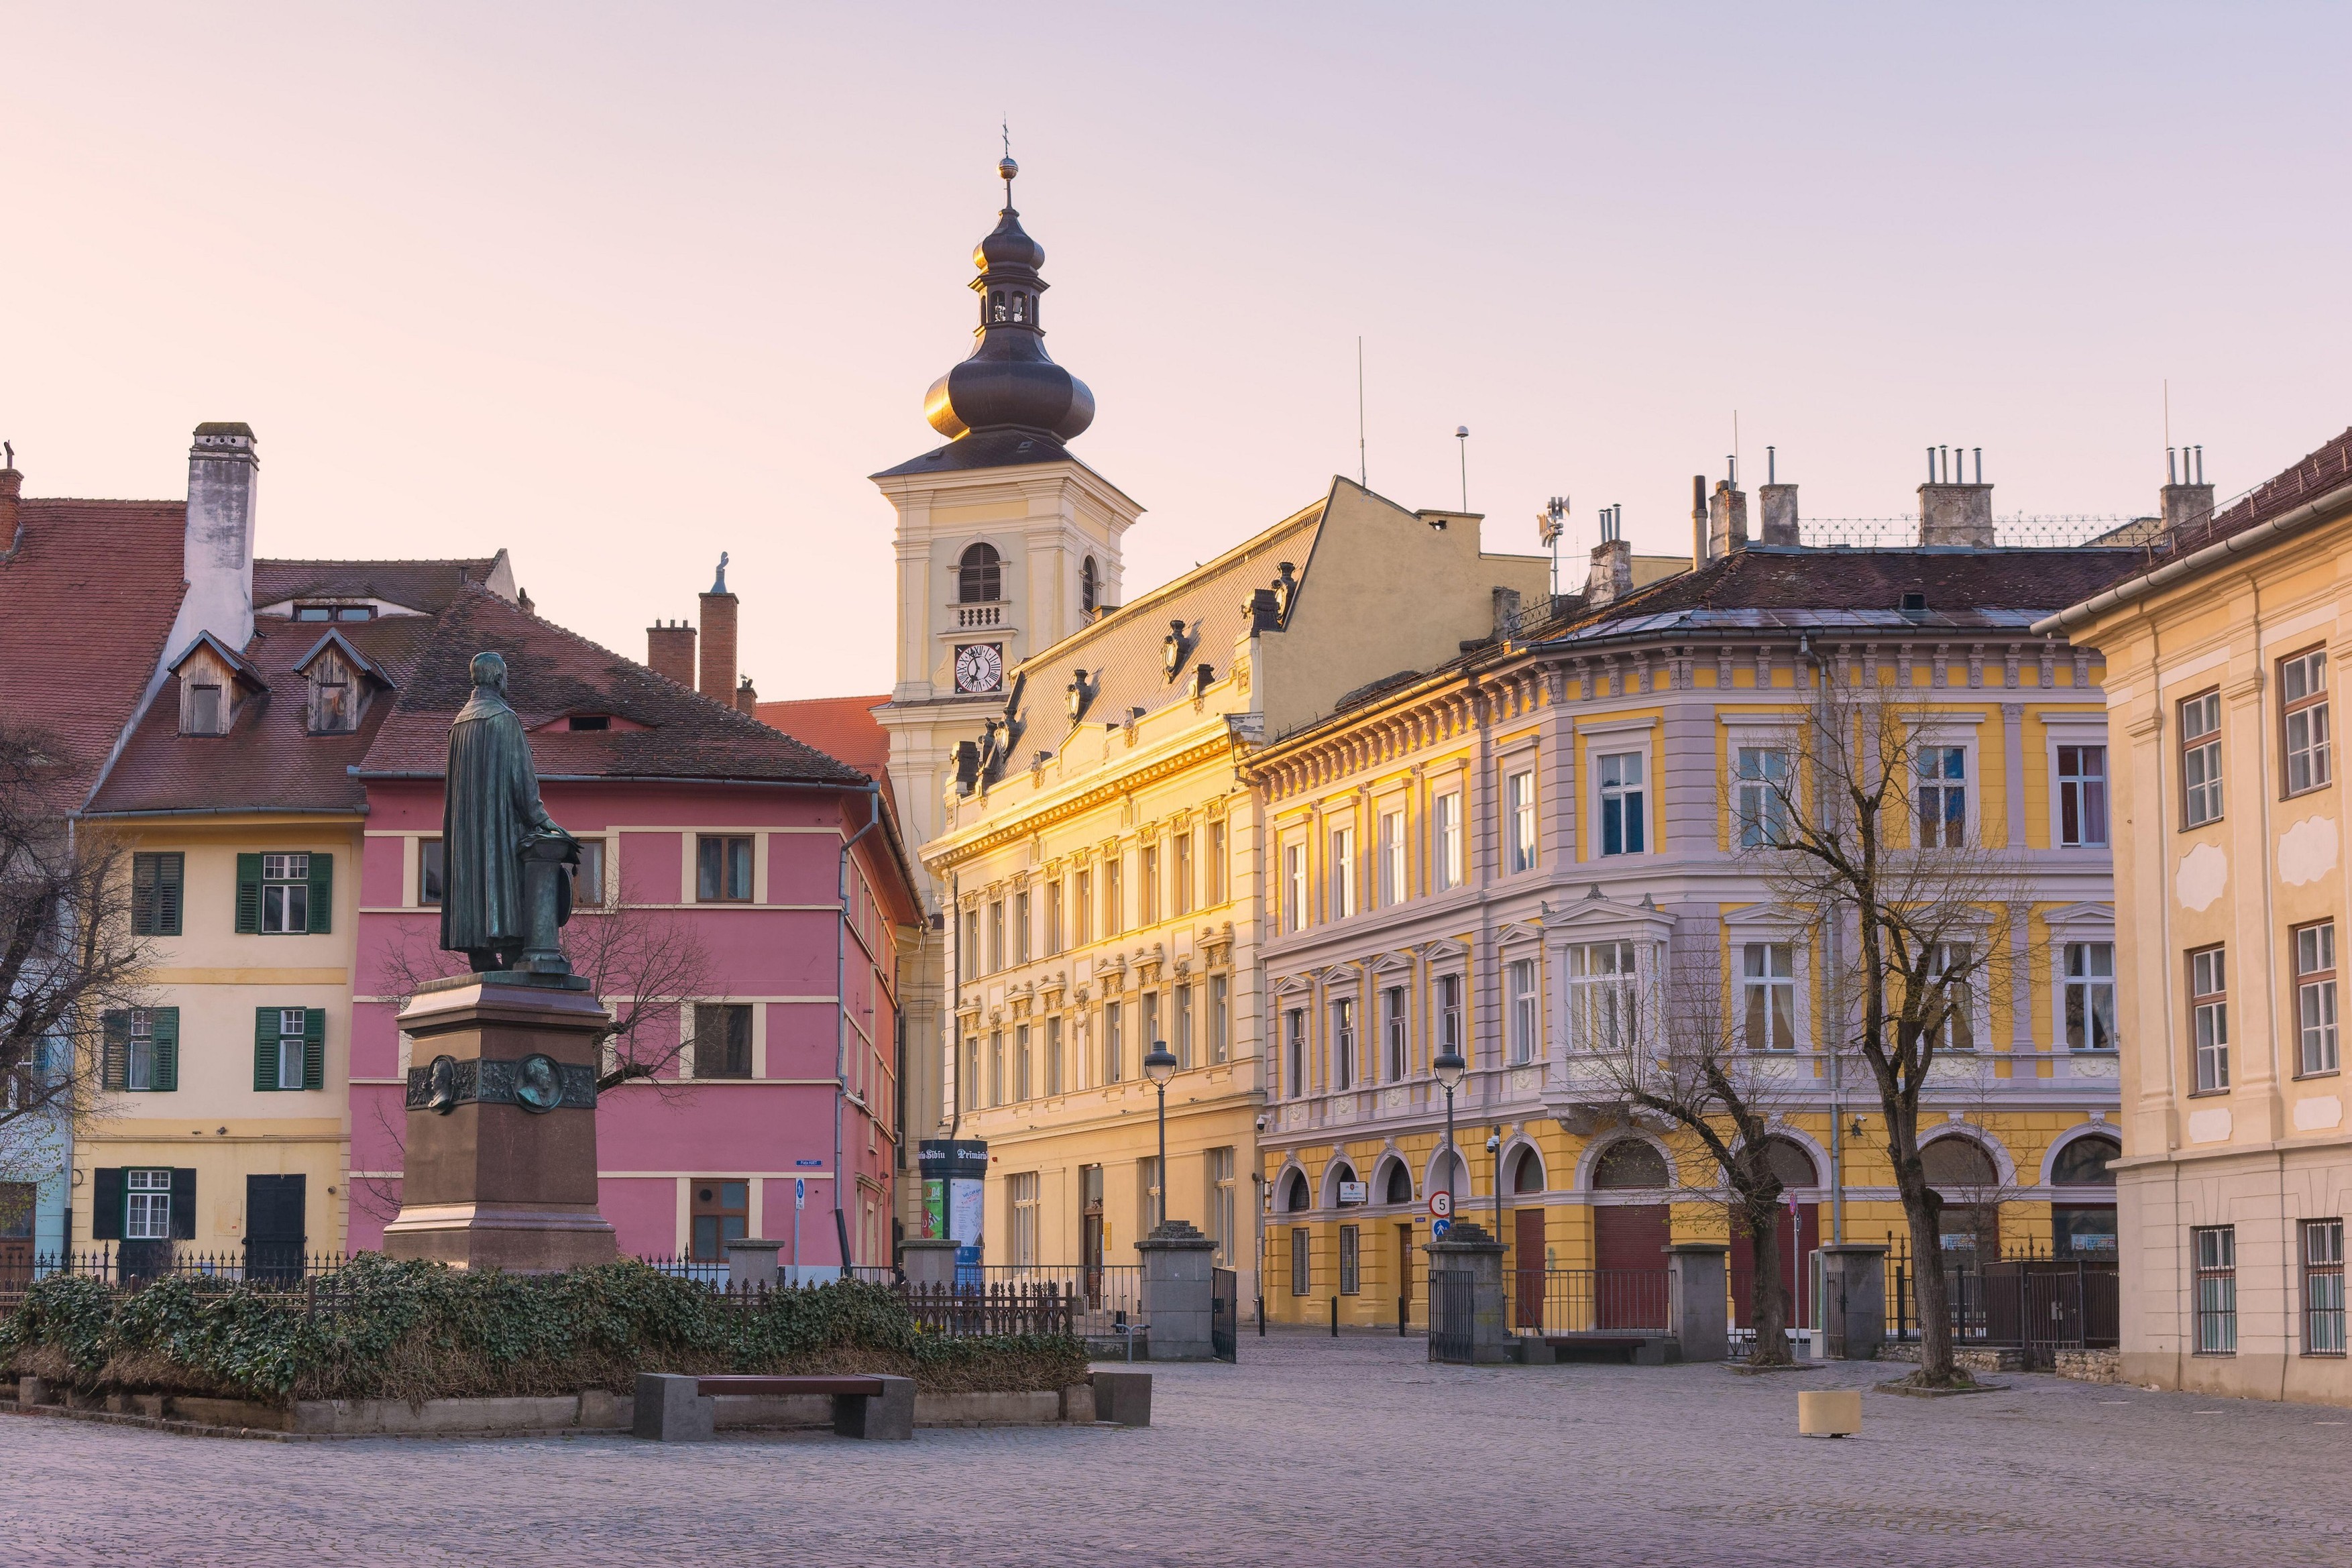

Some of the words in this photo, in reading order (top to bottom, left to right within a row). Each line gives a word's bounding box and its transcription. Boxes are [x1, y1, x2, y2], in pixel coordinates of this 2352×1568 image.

[974, 646, 983, 655] XII
[959, 657, 969, 665] X
[989, 654, 999, 663] II
[957, 666, 966, 674] IX
[976, 681, 983, 691] VI
[985, 679, 992, 689] V
[926, 1150, 945, 1160] Sibiu
[1439, 1198, 1445, 1211] 5
